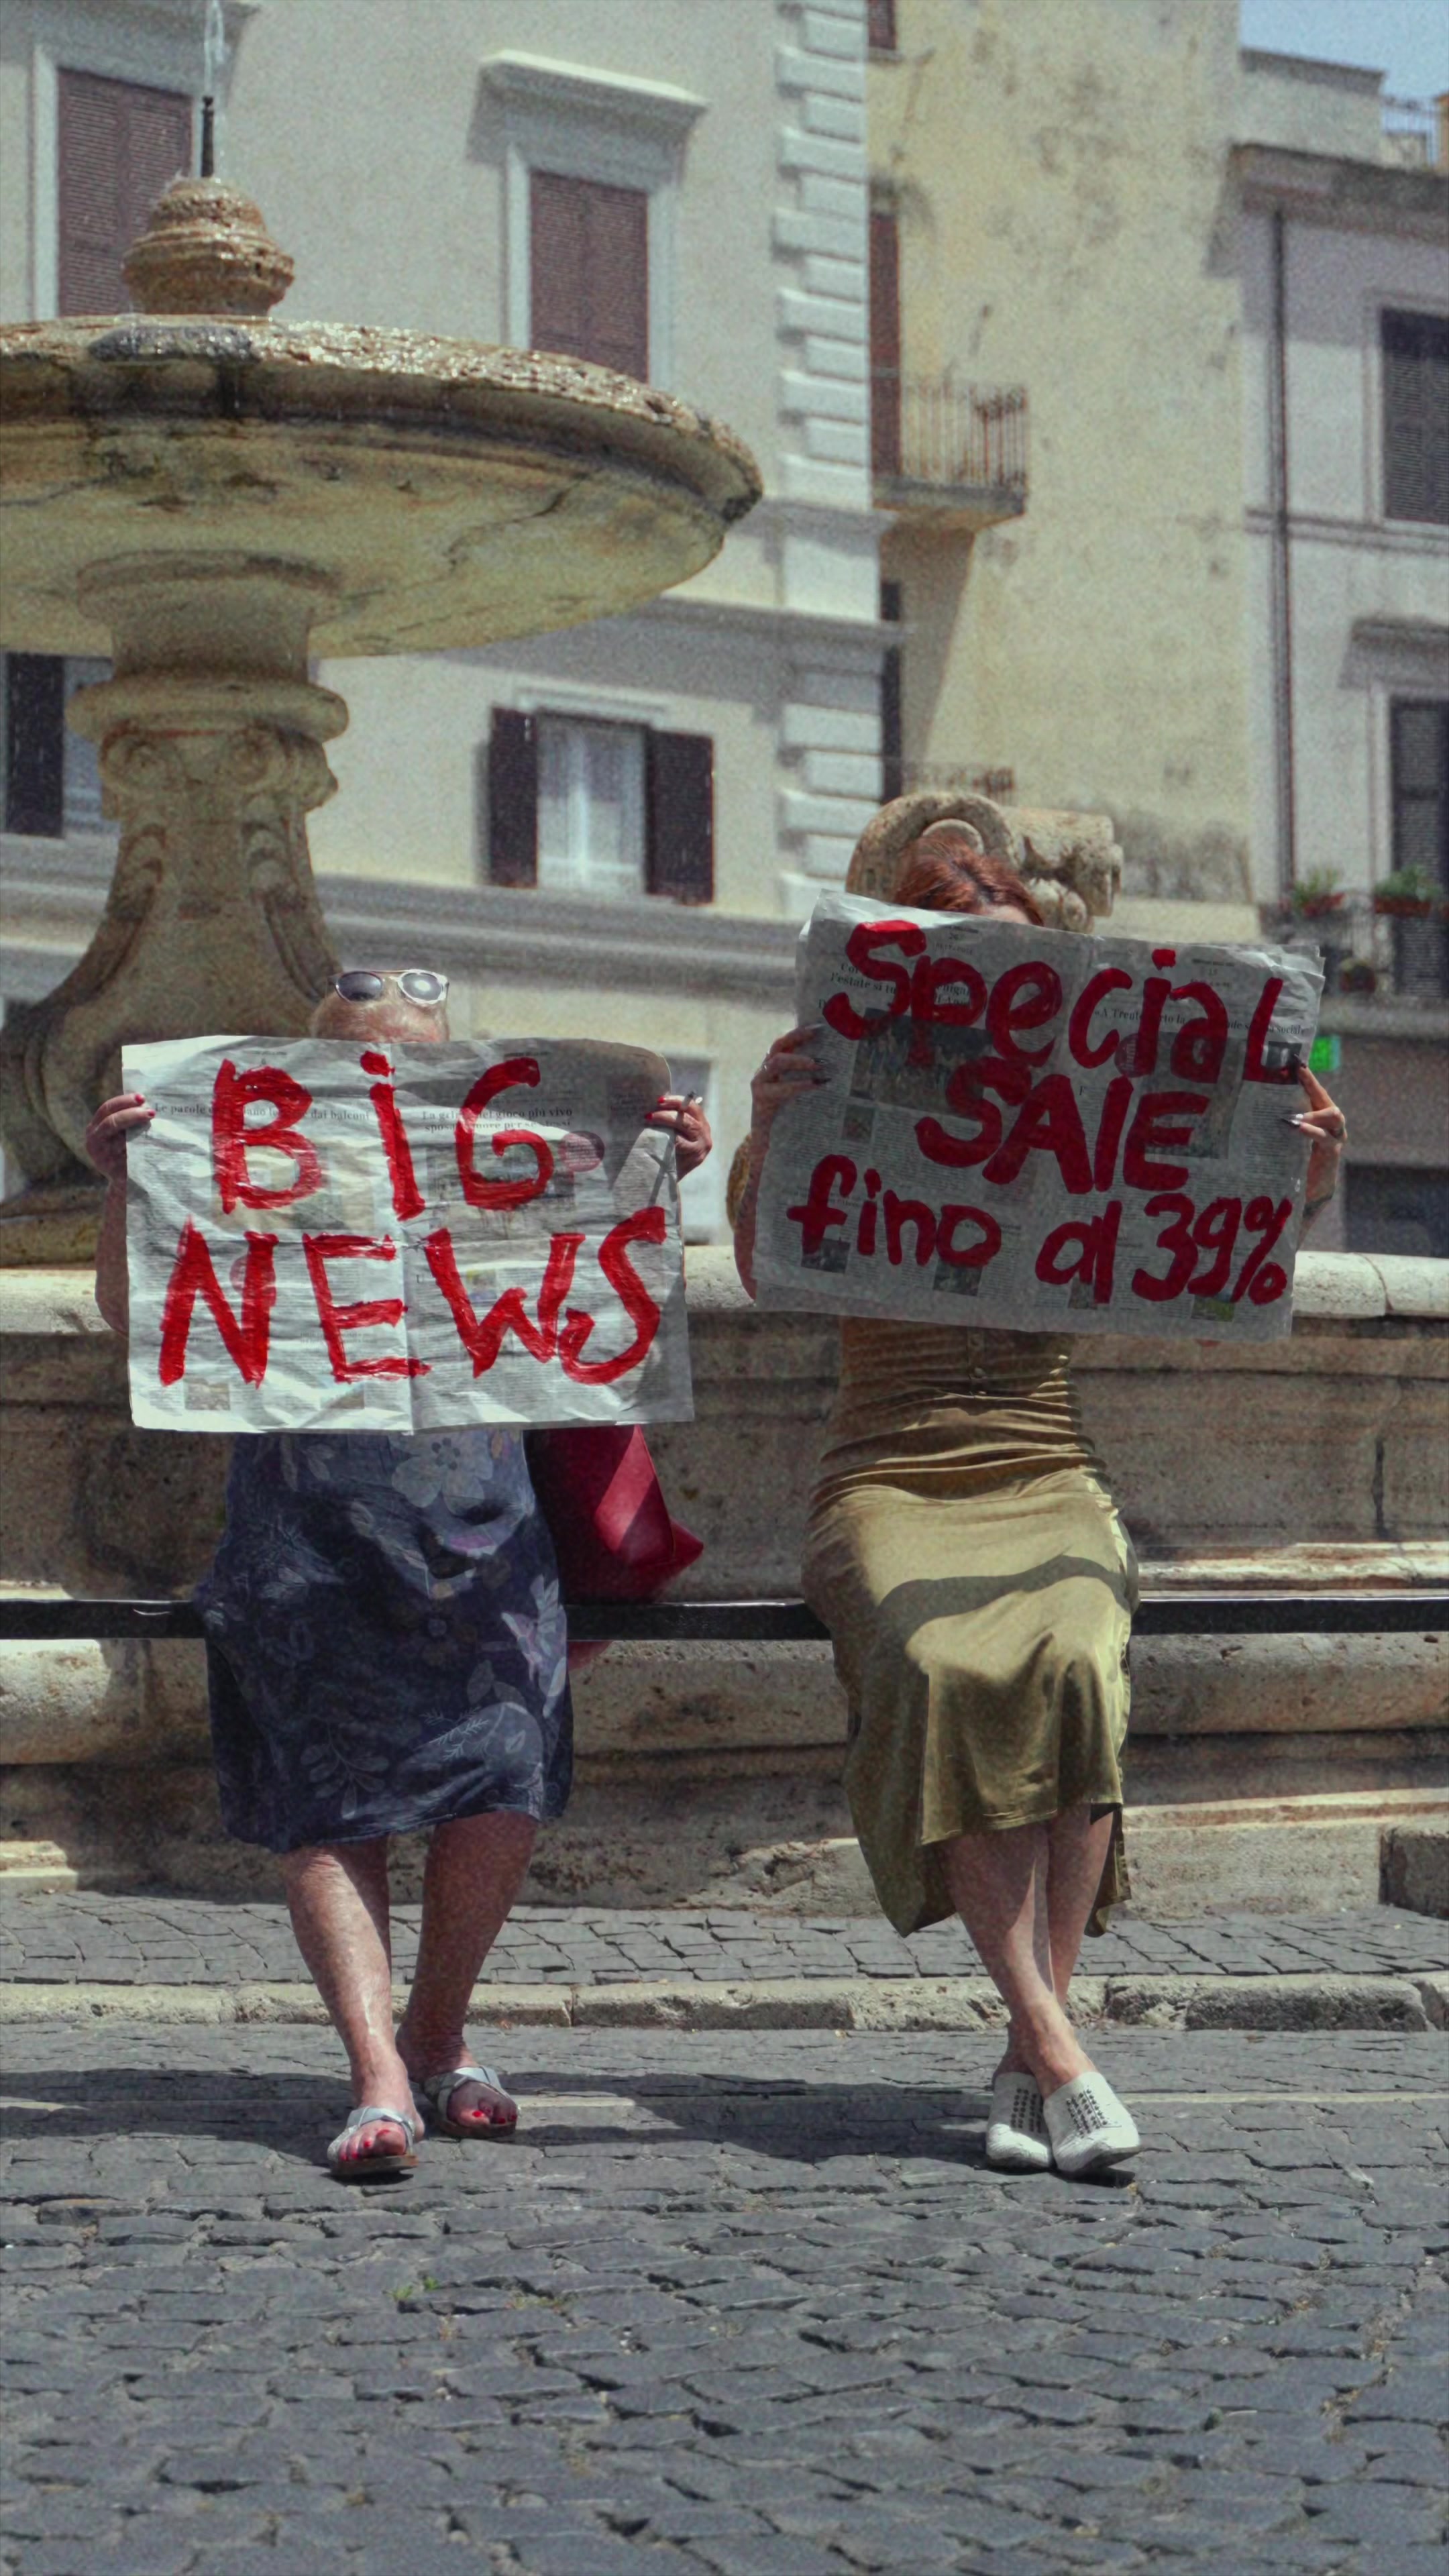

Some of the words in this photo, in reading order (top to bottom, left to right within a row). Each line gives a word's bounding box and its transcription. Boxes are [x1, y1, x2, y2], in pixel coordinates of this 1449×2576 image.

[170, 1103, 207, 1115] parole
[311, 1109, 327, 1119] dai
[331, 1110, 370, 1120] balconi
[495, 1109, 525, 1121] gioco
[548, 1106, 573, 1117] vivo
[786, 1155, 1002, 1266] fino
[1131, 1192, 1292, 1305] 39%
[158, 1205, 667, 1389] NEWS
